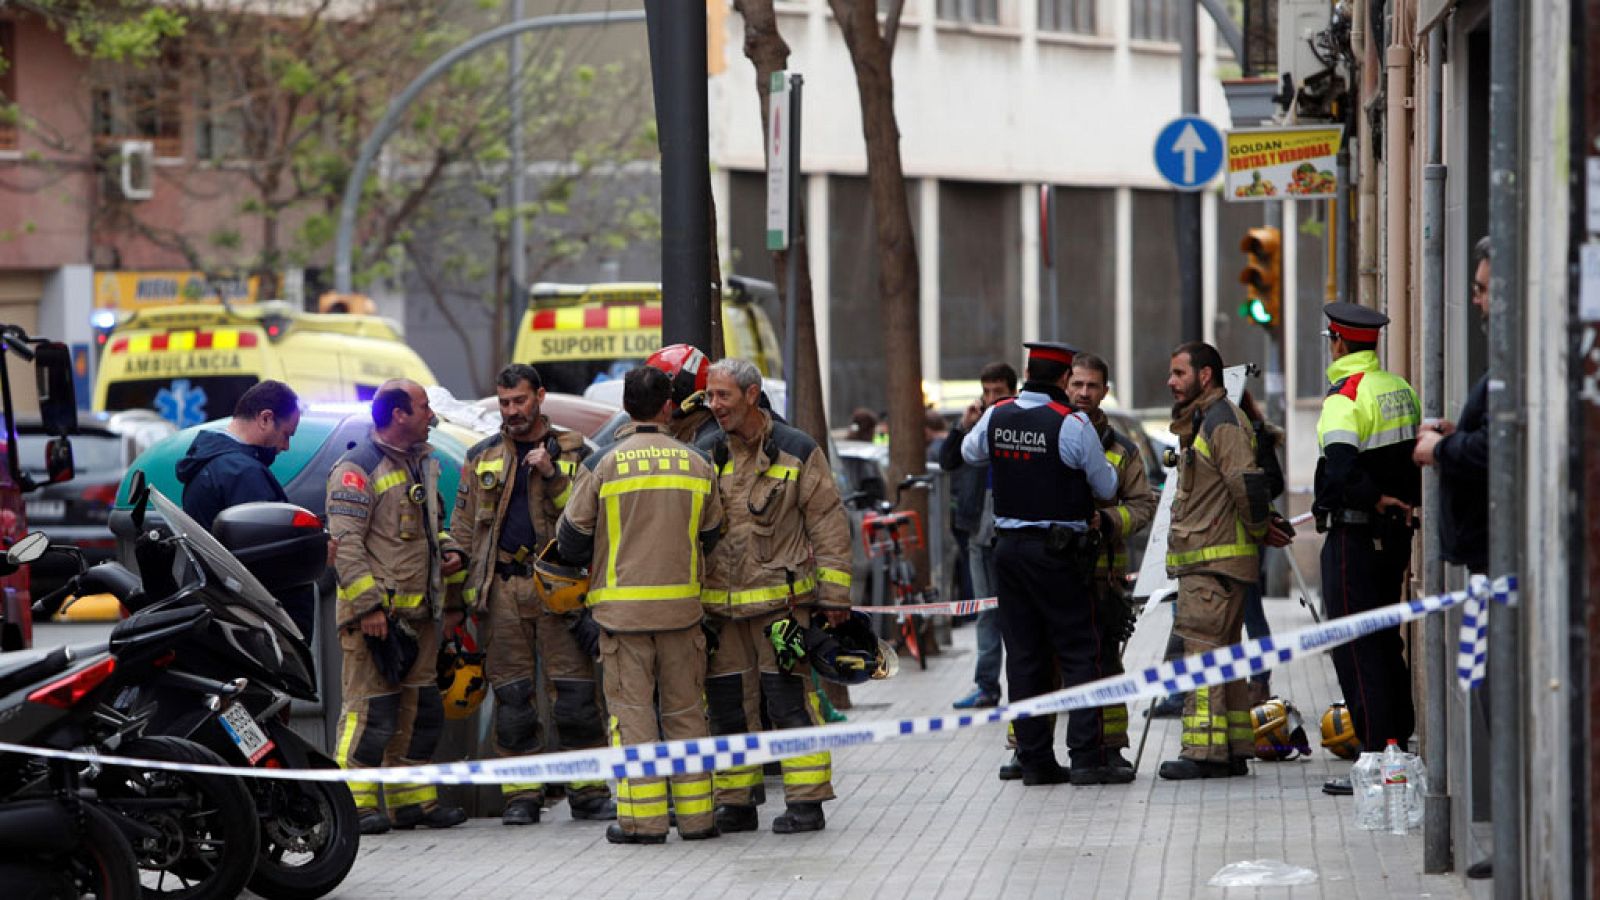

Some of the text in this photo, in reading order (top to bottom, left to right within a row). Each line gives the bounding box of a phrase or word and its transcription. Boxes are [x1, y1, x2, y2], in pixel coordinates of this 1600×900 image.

[1230, 141, 1281, 155] GOLDAN
[1230, 143, 1331, 171] FRUTAS Y VERDURAS
[542, 336, 617, 355] SUPORT
[995, 428, 1047, 446] POLICIA
[616, 445, 689, 462] bombers
